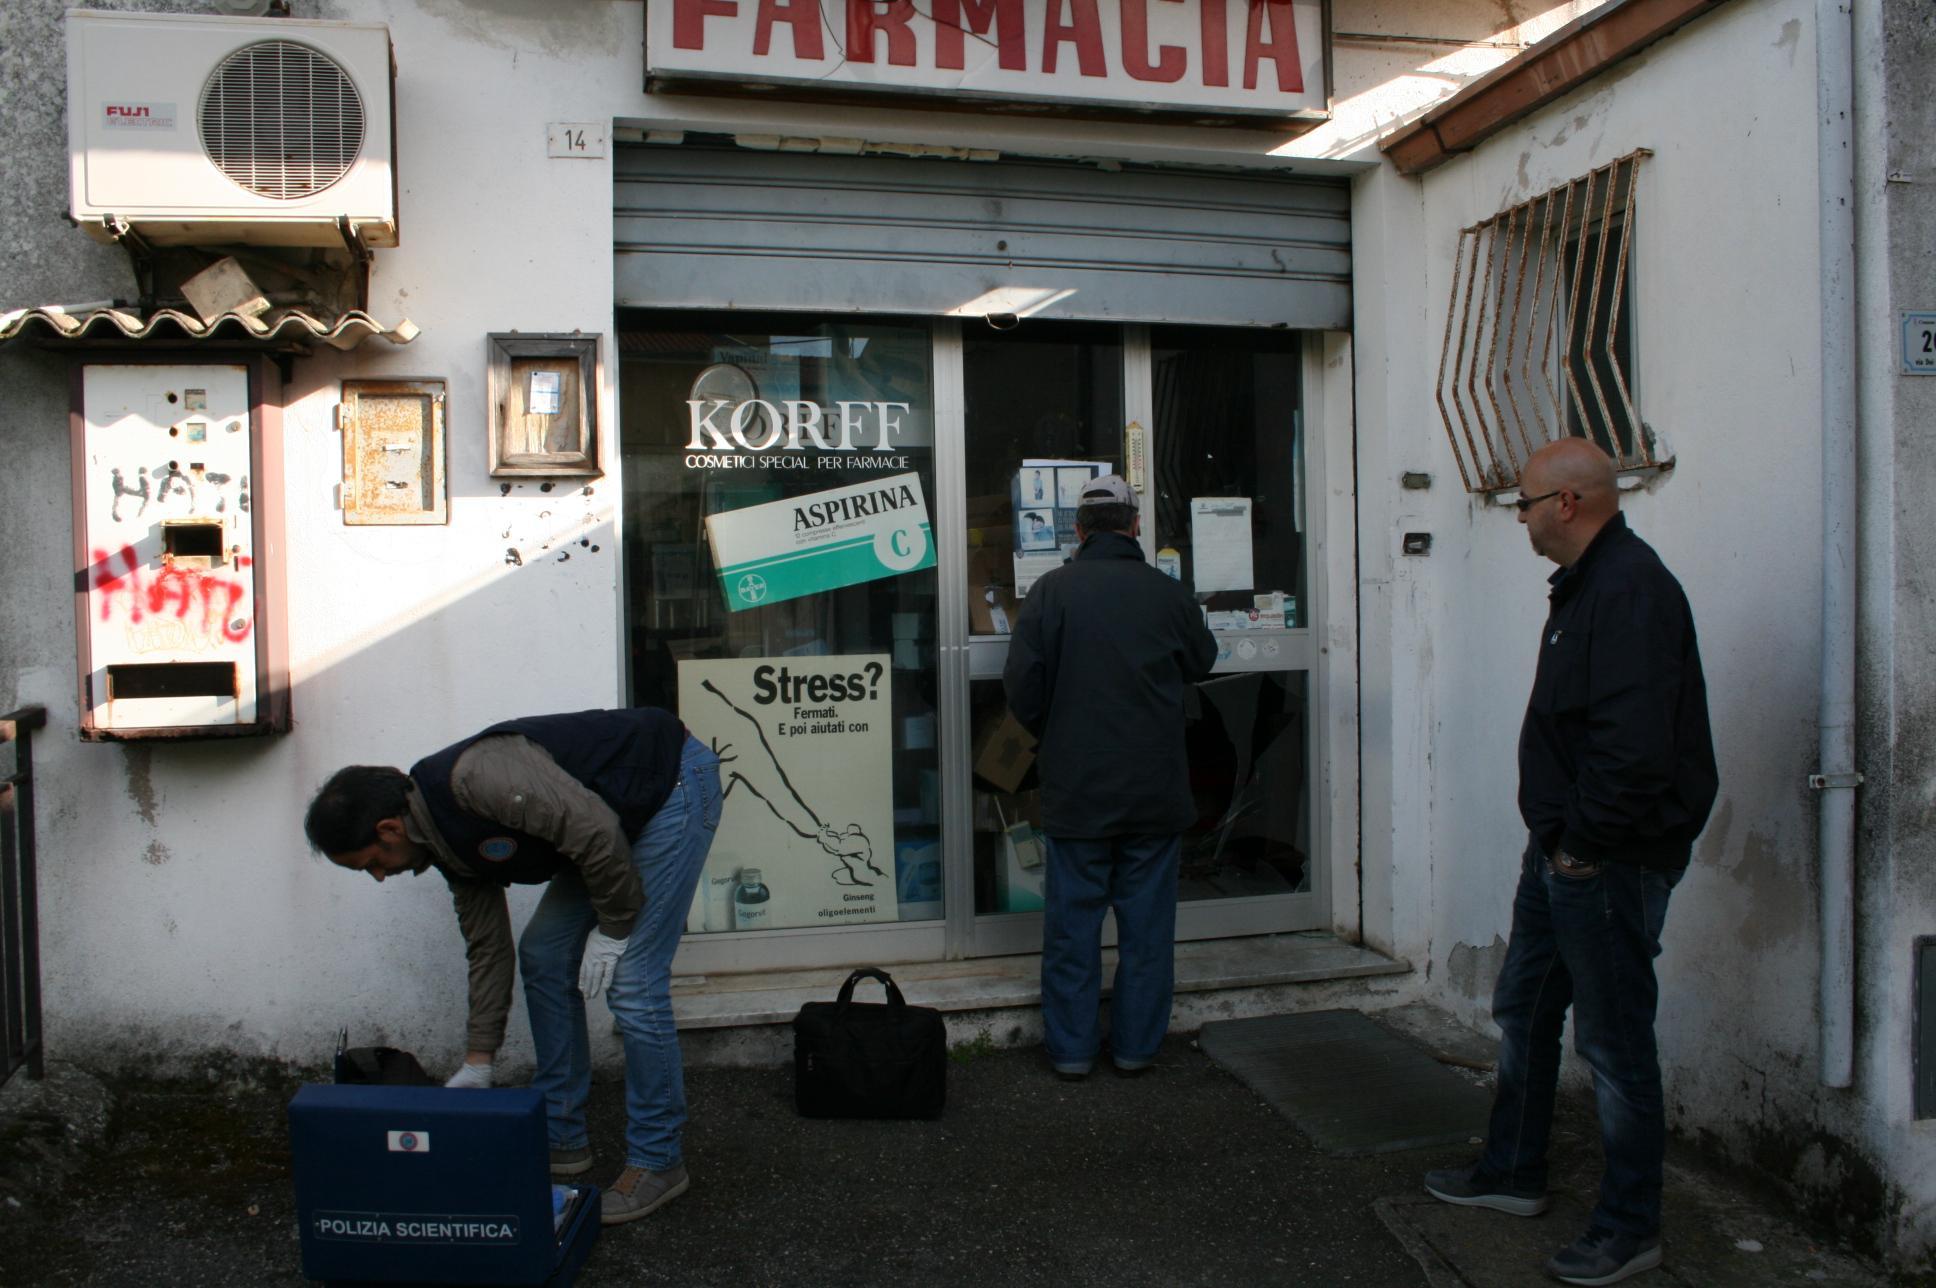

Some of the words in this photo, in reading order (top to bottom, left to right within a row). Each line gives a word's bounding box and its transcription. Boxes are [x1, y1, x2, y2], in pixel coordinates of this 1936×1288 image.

[673, 0, 1304, 93] FARMACIA
[106, 106, 150, 117] FUJI
[564, 129, 586, 151] 14
[685, 399, 910, 451] KORFF
[685, 454, 755, 470] COSMETICI
[817, 456, 842, 470] PER
[847, 456, 910, 470] FARMACIE
[794, 486, 917, 531] ASPIRINA
[891, 529, 911, 557] C
[752, 661, 884, 705] Stress?
[793, 706, 839, 720] Fermati.
[778, 723, 787, 736] E
[789, 722, 808, 738] poi
[810, 721, 846, 735] aiutati
[848, 722, 869, 734] con
[842, 892, 875, 904] Ginseng
[818, 905, 876, 918] oligoelementi
[321, 1219, 391, 1236] POLIZIA
[396, 1222, 513, 1239] SCIENTIFICA
